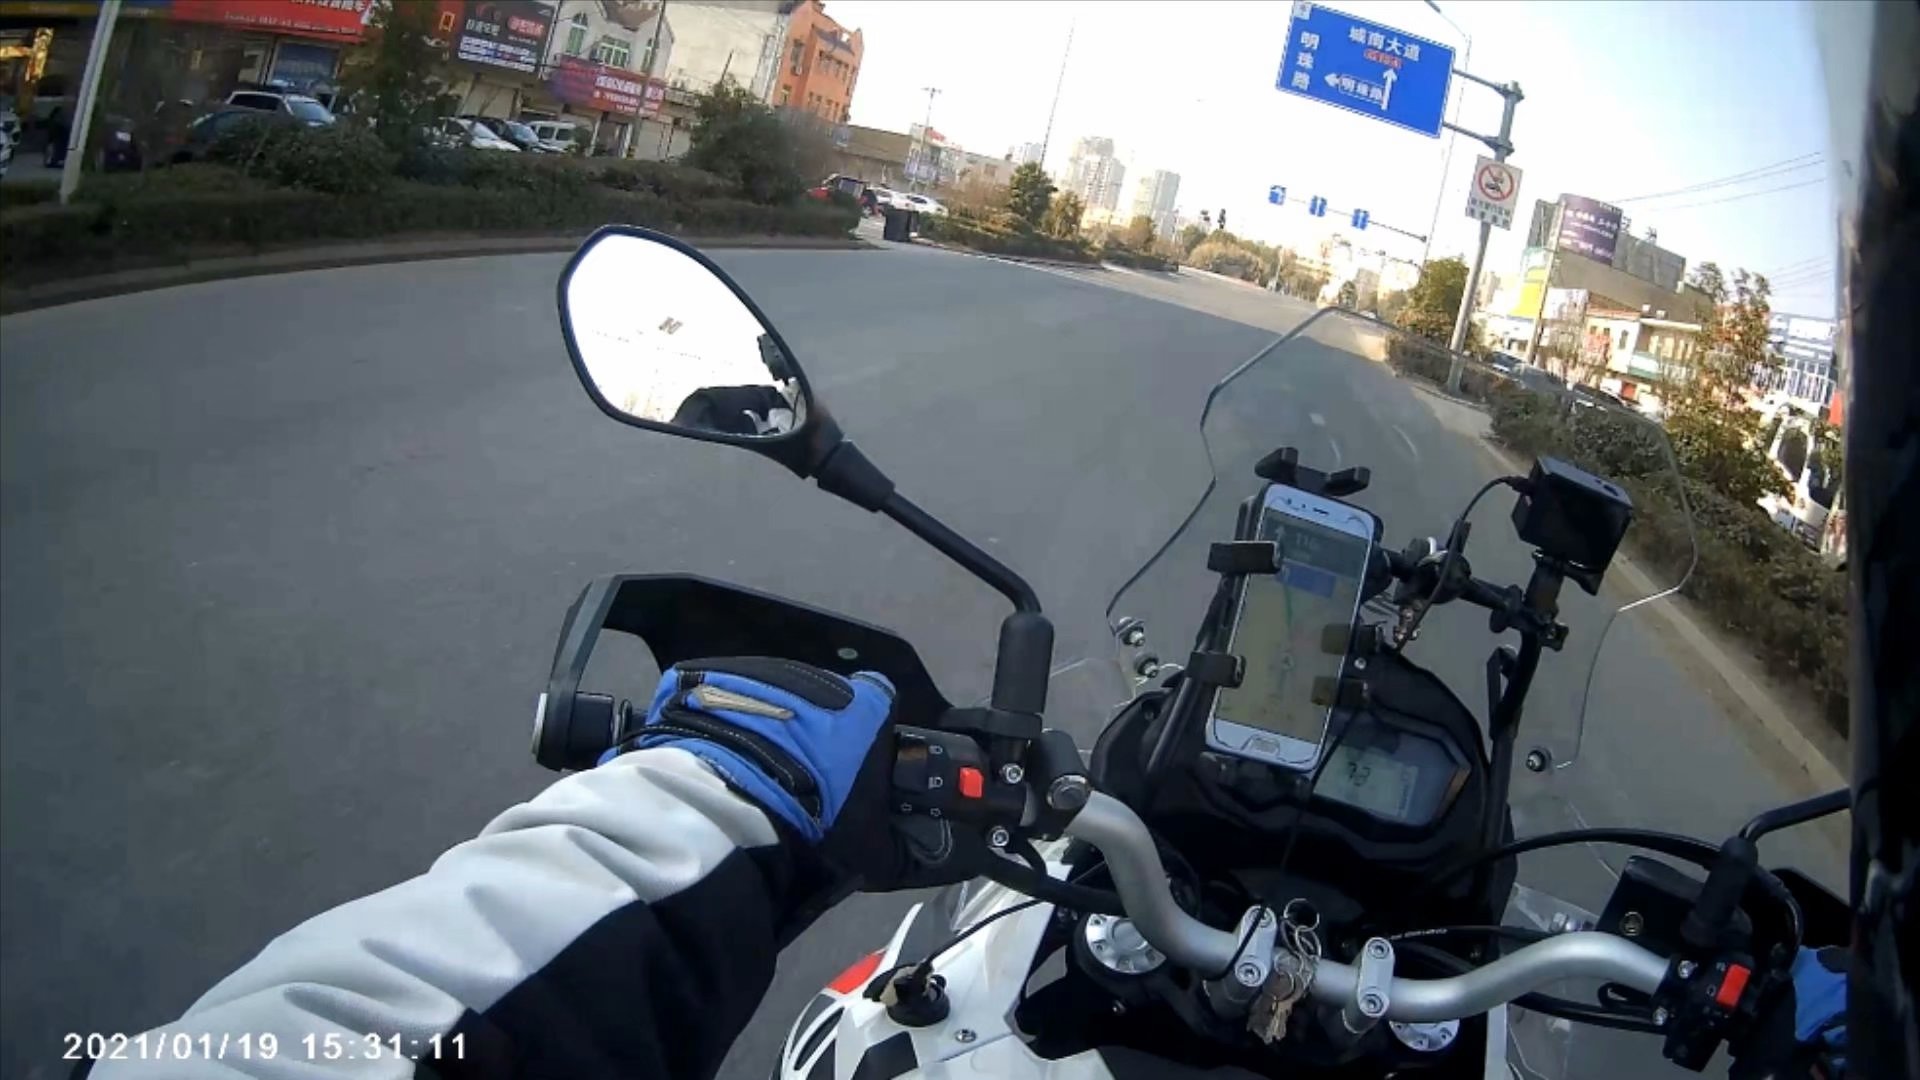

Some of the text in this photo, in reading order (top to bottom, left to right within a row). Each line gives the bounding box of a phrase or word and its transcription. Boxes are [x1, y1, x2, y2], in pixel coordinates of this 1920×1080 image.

[1291, 31, 1320, 91] 明珠路
[1348, 25, 1421, 62] 城南大道
[1341, 77, 1384, 101] 明珠路
